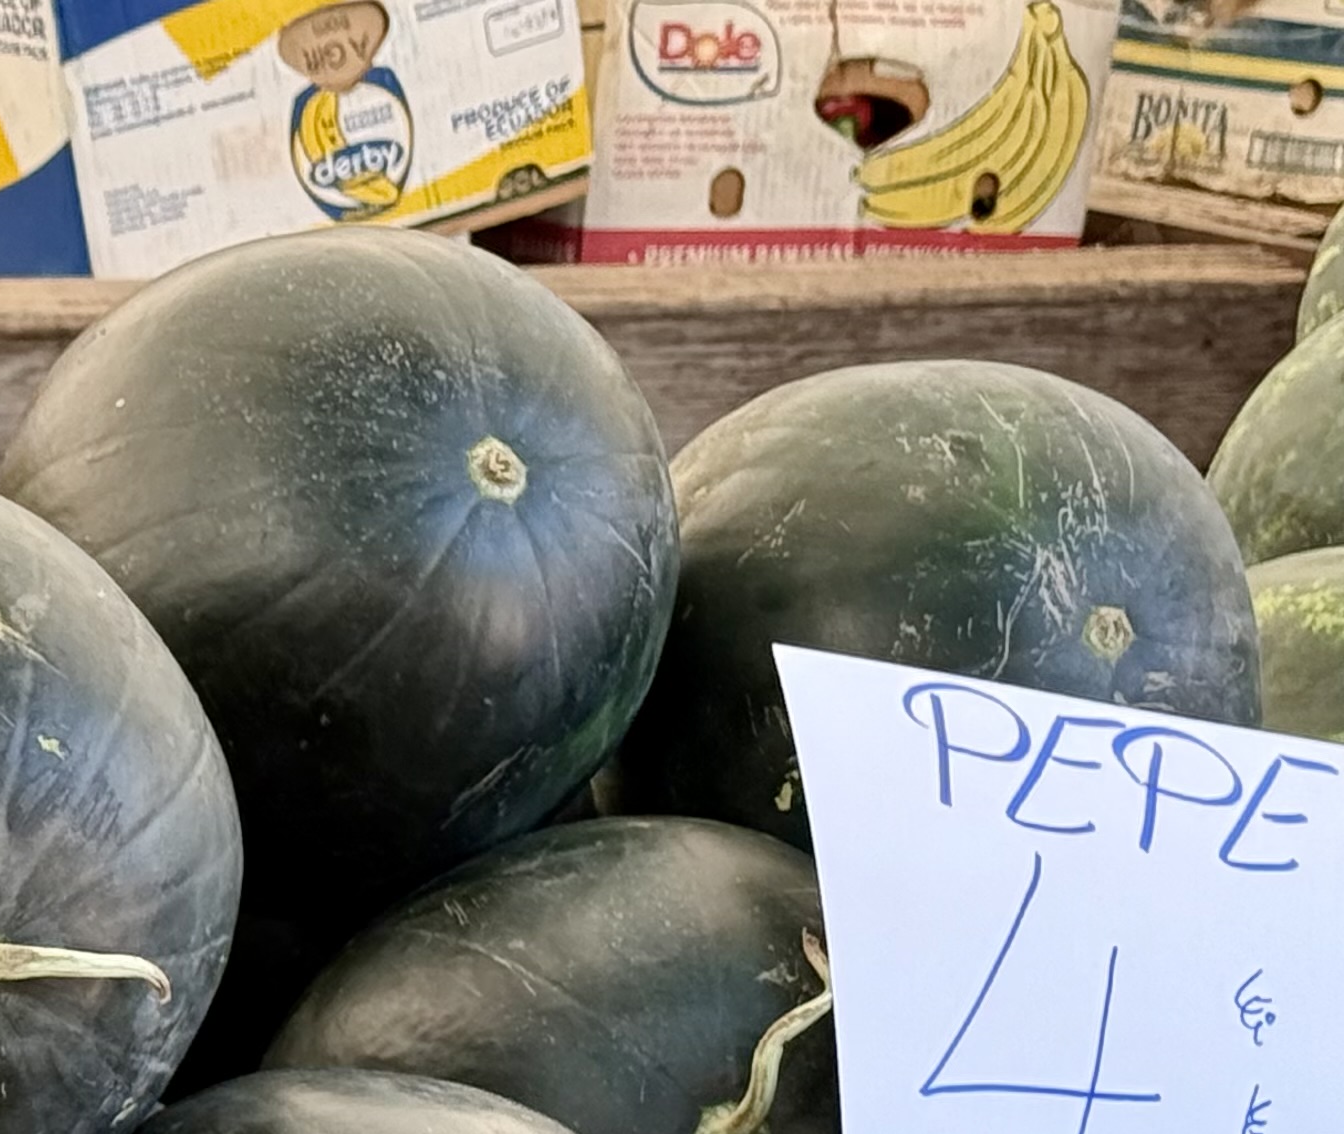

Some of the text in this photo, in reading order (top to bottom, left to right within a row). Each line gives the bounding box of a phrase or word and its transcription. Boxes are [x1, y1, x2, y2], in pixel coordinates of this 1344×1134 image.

[659, 20, 762, 67] Dole
[450, 74, 571, 132] PRODUCE OF
[1131, 92, 1229, 160] BONITA
[314, 141, 401, 187] derby
[903, 683, 1339, 870] PEPE
